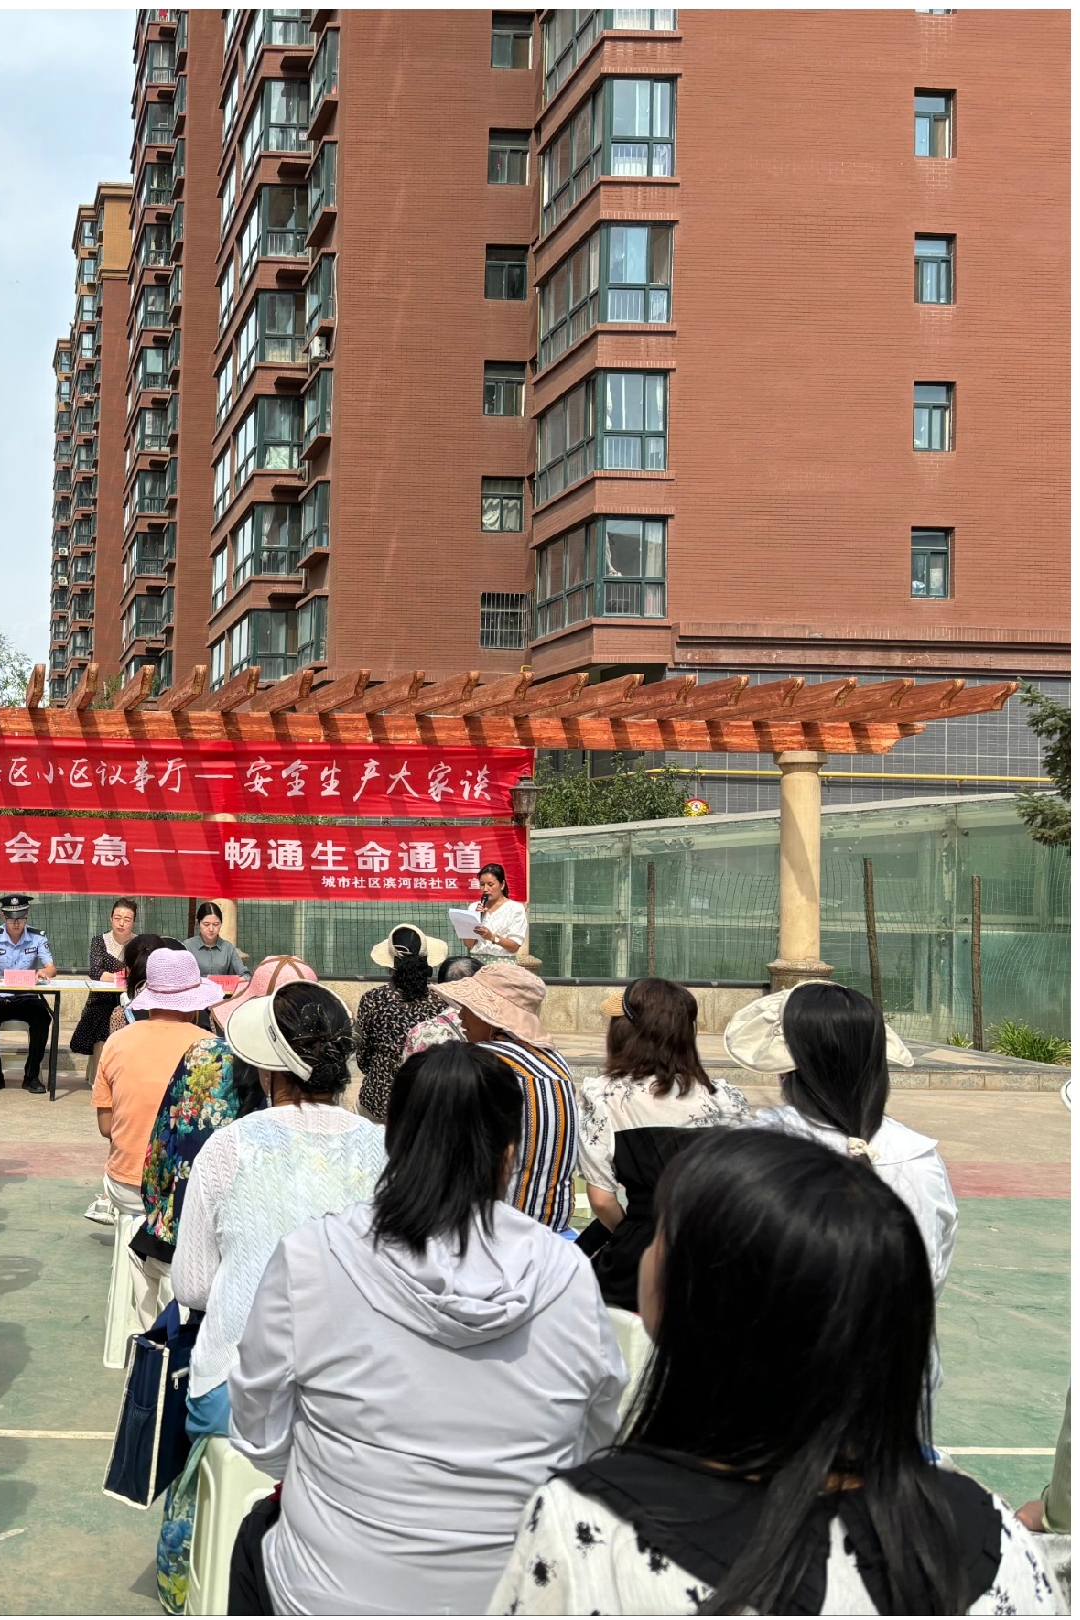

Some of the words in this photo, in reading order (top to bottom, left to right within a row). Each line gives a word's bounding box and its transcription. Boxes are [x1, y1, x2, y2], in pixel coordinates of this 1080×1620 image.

[321, 875, 459, 890] 城市社区滨河路社区
